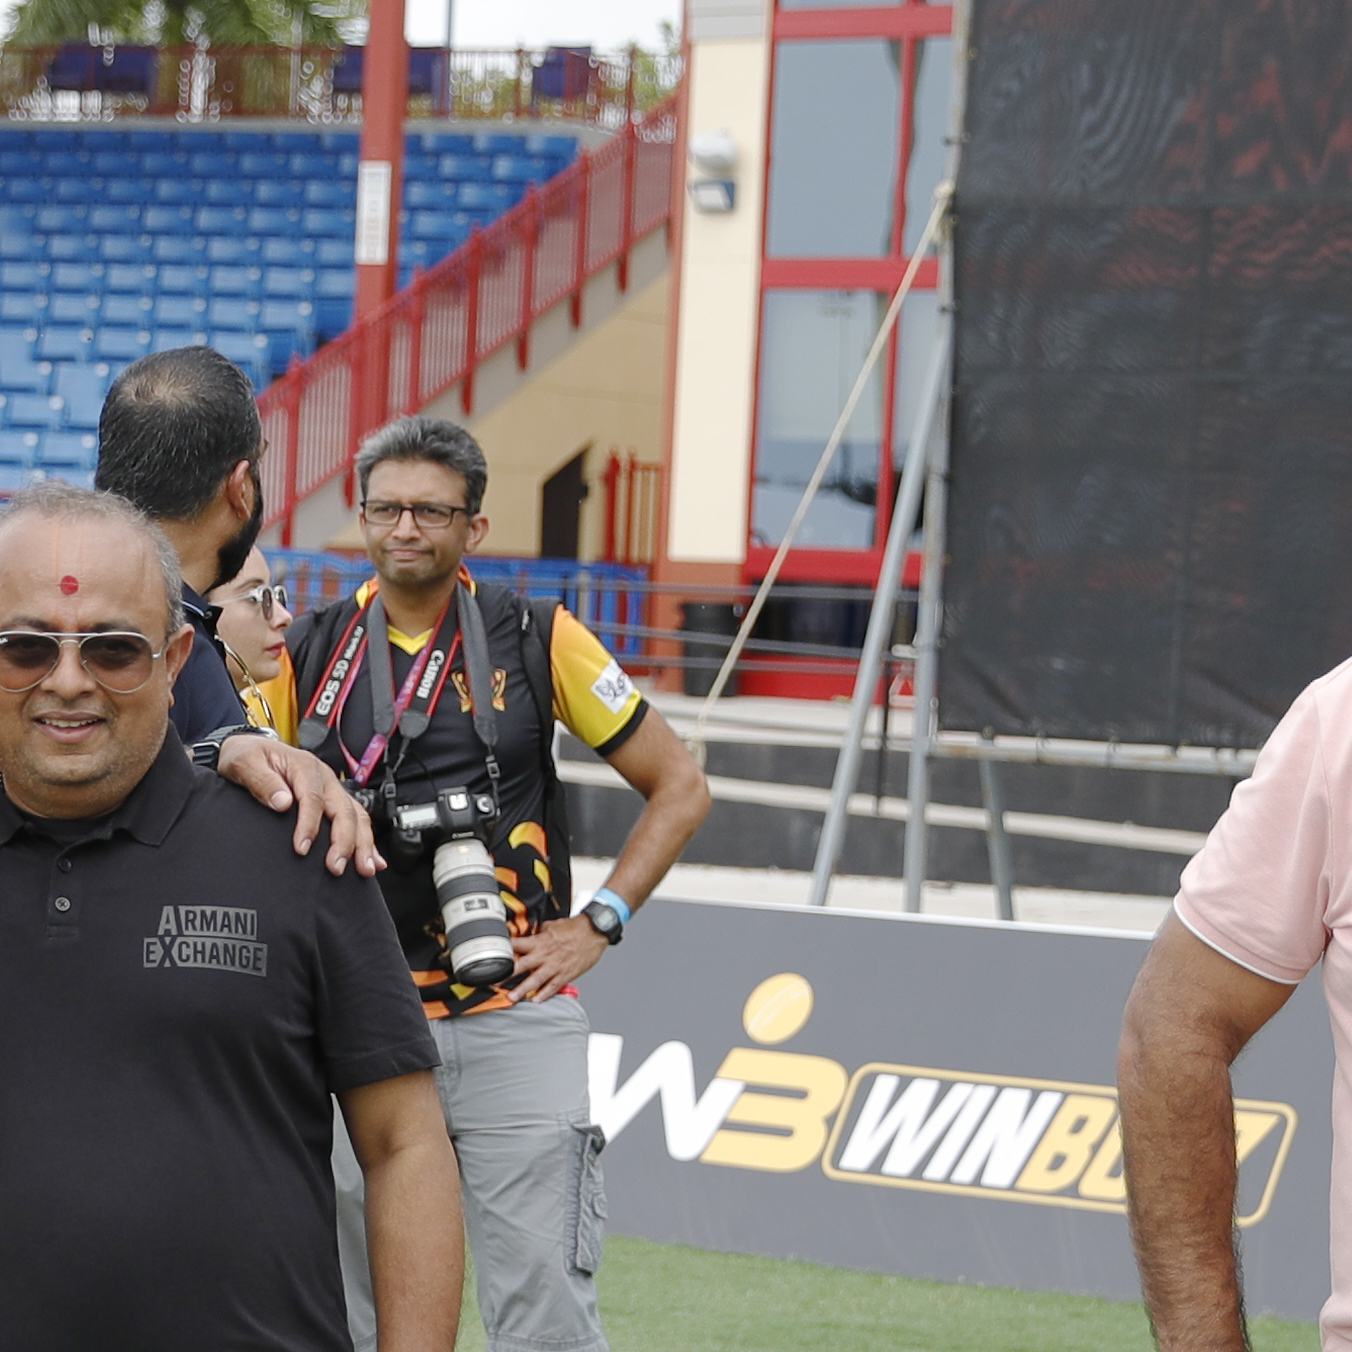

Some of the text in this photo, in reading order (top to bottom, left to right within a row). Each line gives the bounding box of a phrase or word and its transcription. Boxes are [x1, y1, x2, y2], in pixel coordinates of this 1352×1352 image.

[416, 650, 445, 699] Canon
[315, 679, 340, 716] EOS
[158, 905, 257, 938] ARMANI
[145, 937, 265, 973] EXCHANGE
